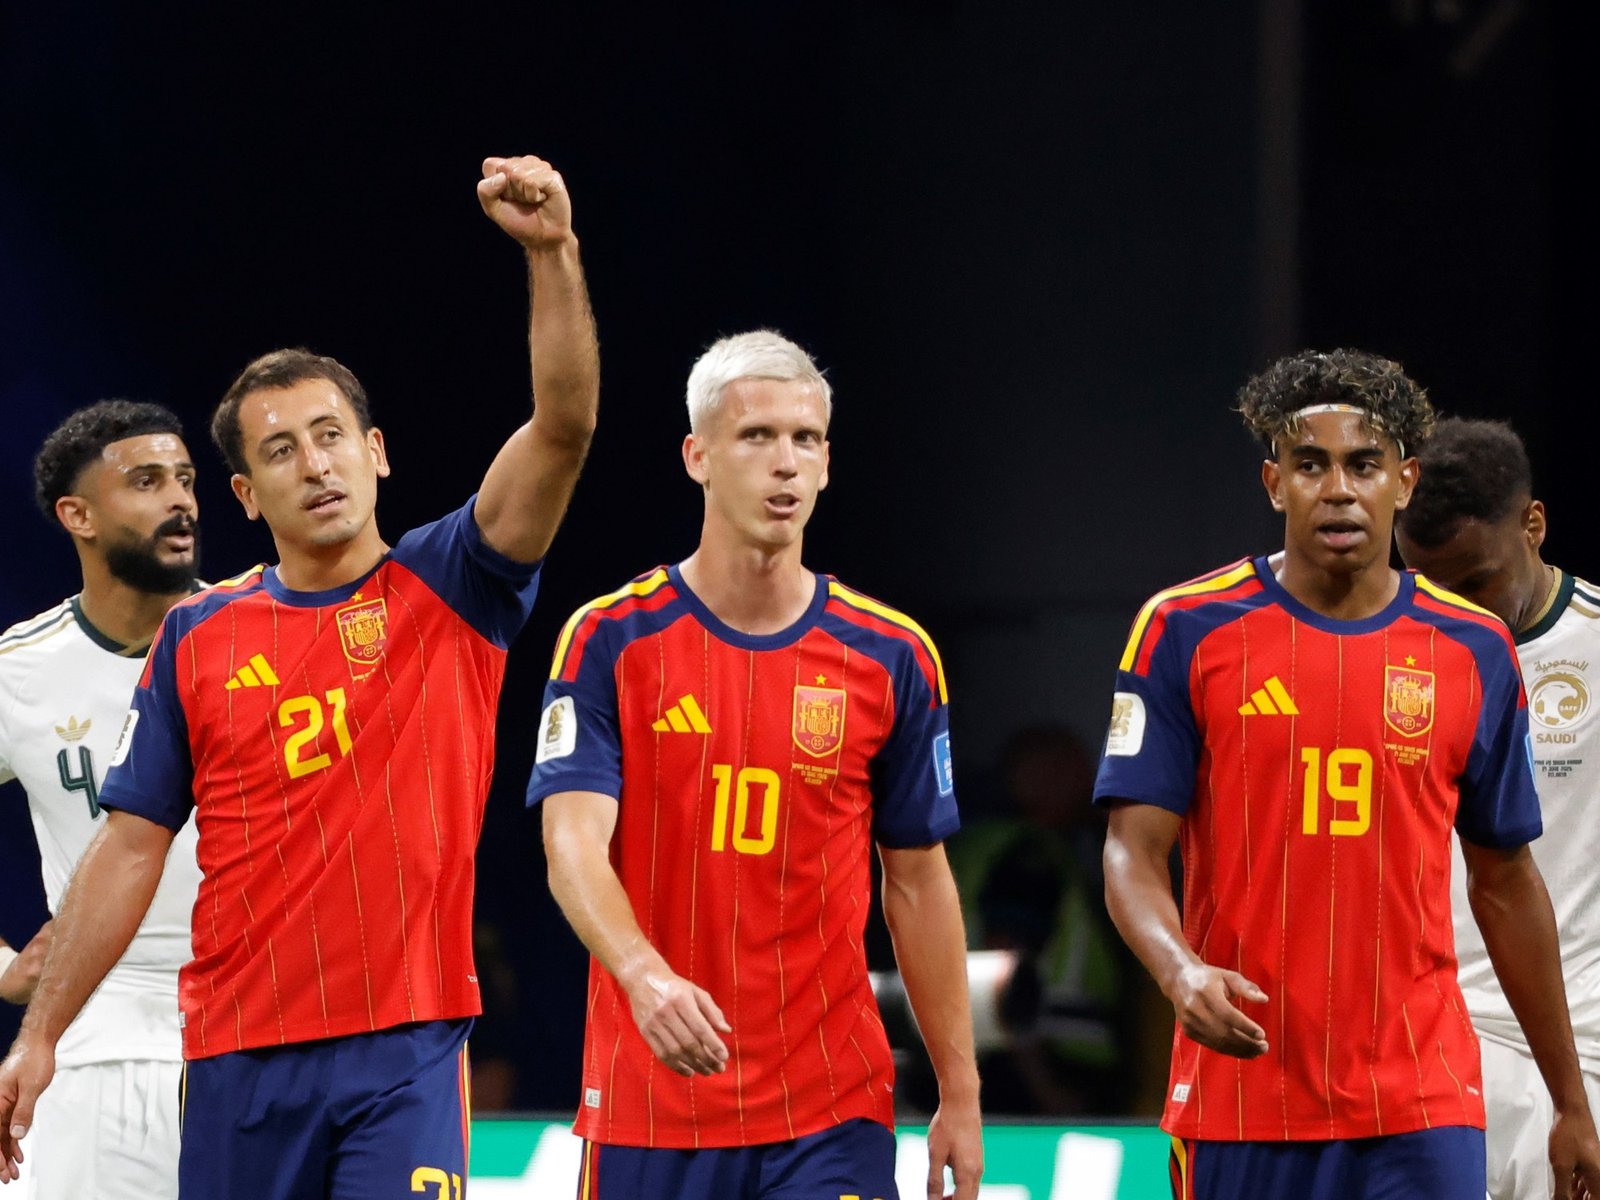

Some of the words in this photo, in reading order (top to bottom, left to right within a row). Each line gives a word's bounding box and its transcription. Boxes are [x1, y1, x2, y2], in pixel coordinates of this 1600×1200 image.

[278, 687, 353, 779] 21
[1536, 733, 1577, 744] SAUDI
[57, 745, 101, 819] 4
[712, 764, 780, 855] 10
[1302, 747, 1372, 836] 19
